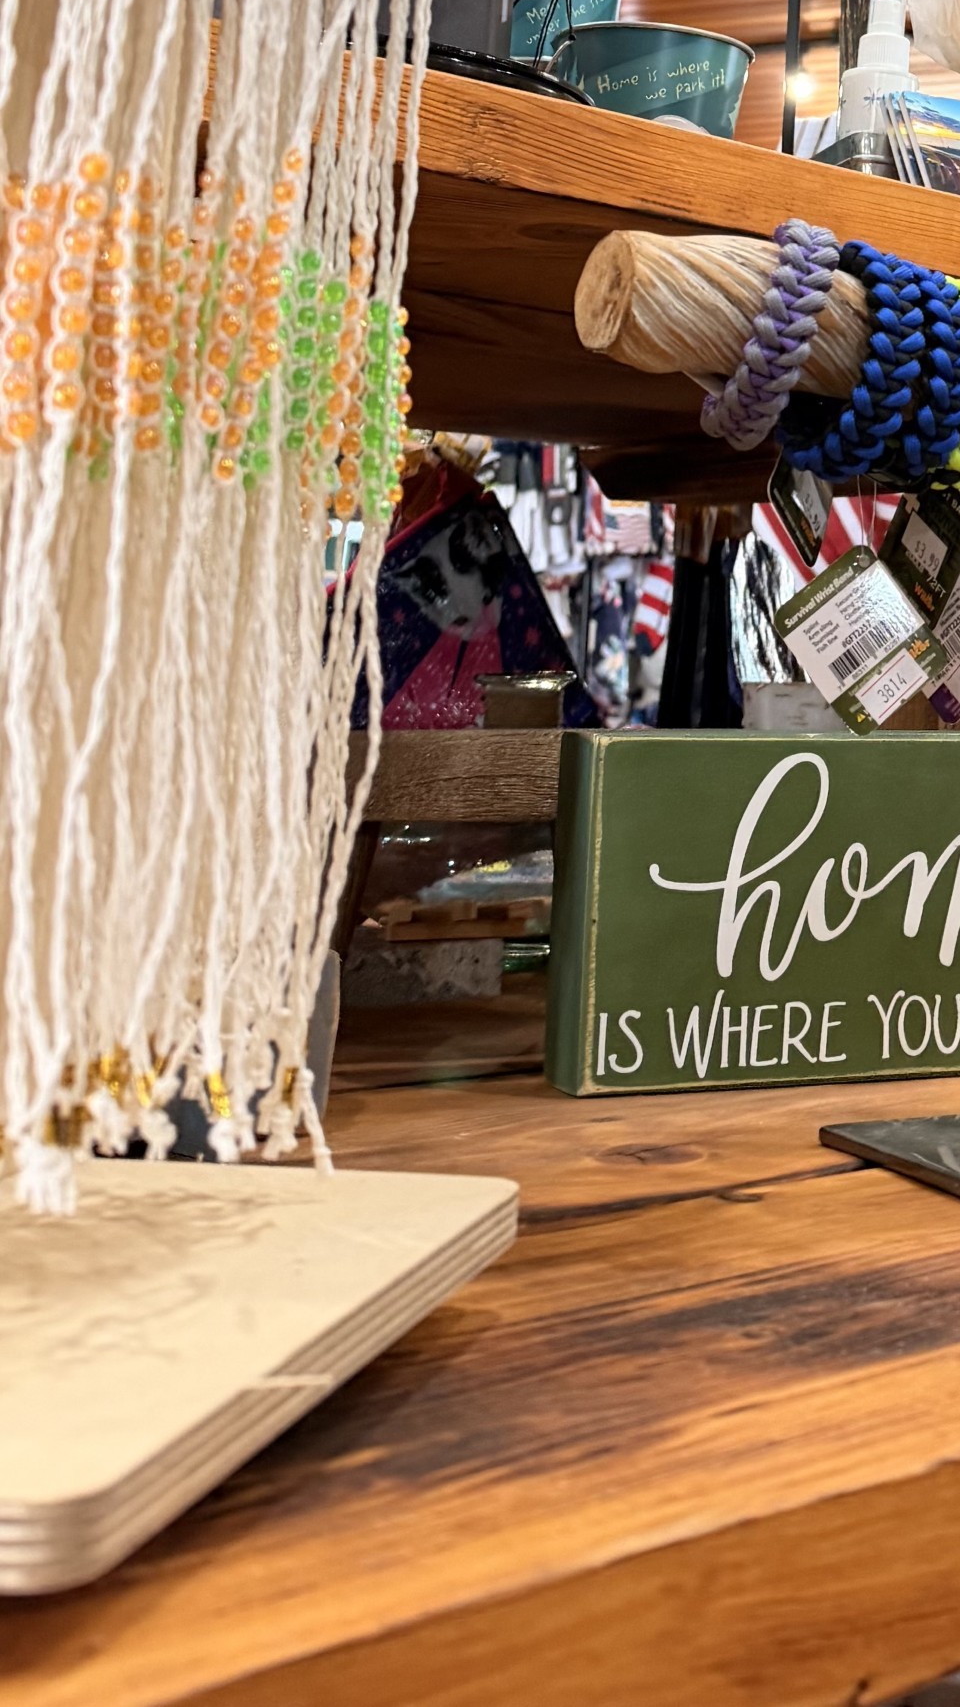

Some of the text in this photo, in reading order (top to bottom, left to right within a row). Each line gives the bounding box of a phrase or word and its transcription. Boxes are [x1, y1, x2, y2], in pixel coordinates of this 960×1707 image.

[597, 60, 710, 94] Home is where
[645, 86, 667, 101] we
[674, 77, 706, 100] park
[784, 595, 819, 629] Survival
[813, 579, 836, 605] Wrist
[876, 676, 909, 705] 3814
[596, 1009, 644, 1076] IS
[667, 989, 847, 1079] WHERE
